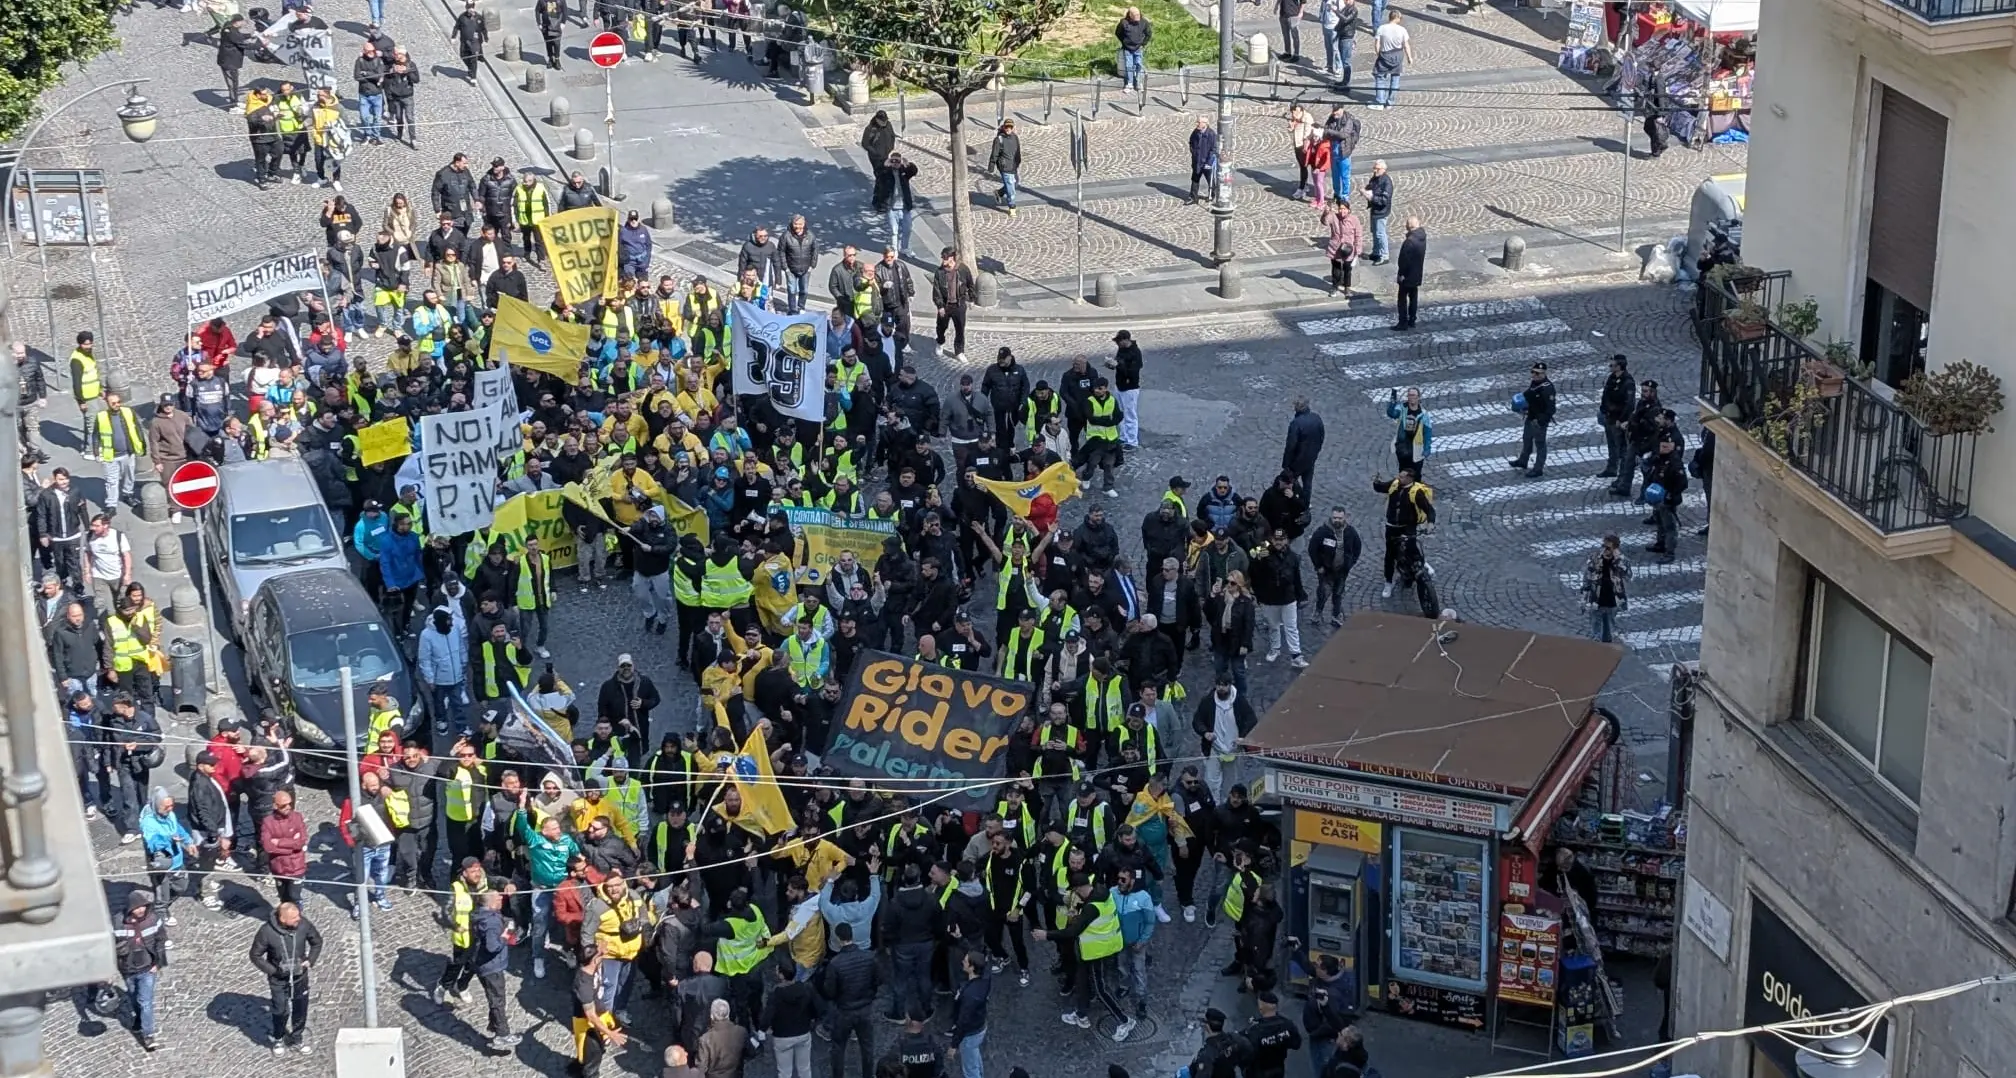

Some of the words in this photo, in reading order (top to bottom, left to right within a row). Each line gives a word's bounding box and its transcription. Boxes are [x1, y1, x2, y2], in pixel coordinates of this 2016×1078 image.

[240, 255, 318, 293] CATANIA
[746, 334, 806, 408] 39
[845, 694, 1009, 764] Rider
[1283, 773, 1322, 788] TICKET
[1325, 780, 1361, 794] POINT
[1360, 762, 1399, 777] TICKET
[1403, 767, 1438, 783] POINT
[1448, 776, 1476, 789] OPEN
[1283, 784, 1331, 798] TOURIST
[1336, 791, 1361, 802] BUS
[1320, 826, 1359, 842] CASH
[1321, 817, 1334, 827] 24
[1336, 820, 1359, 832] hour
[902, 1052, 936, 1064] POLIZIA
